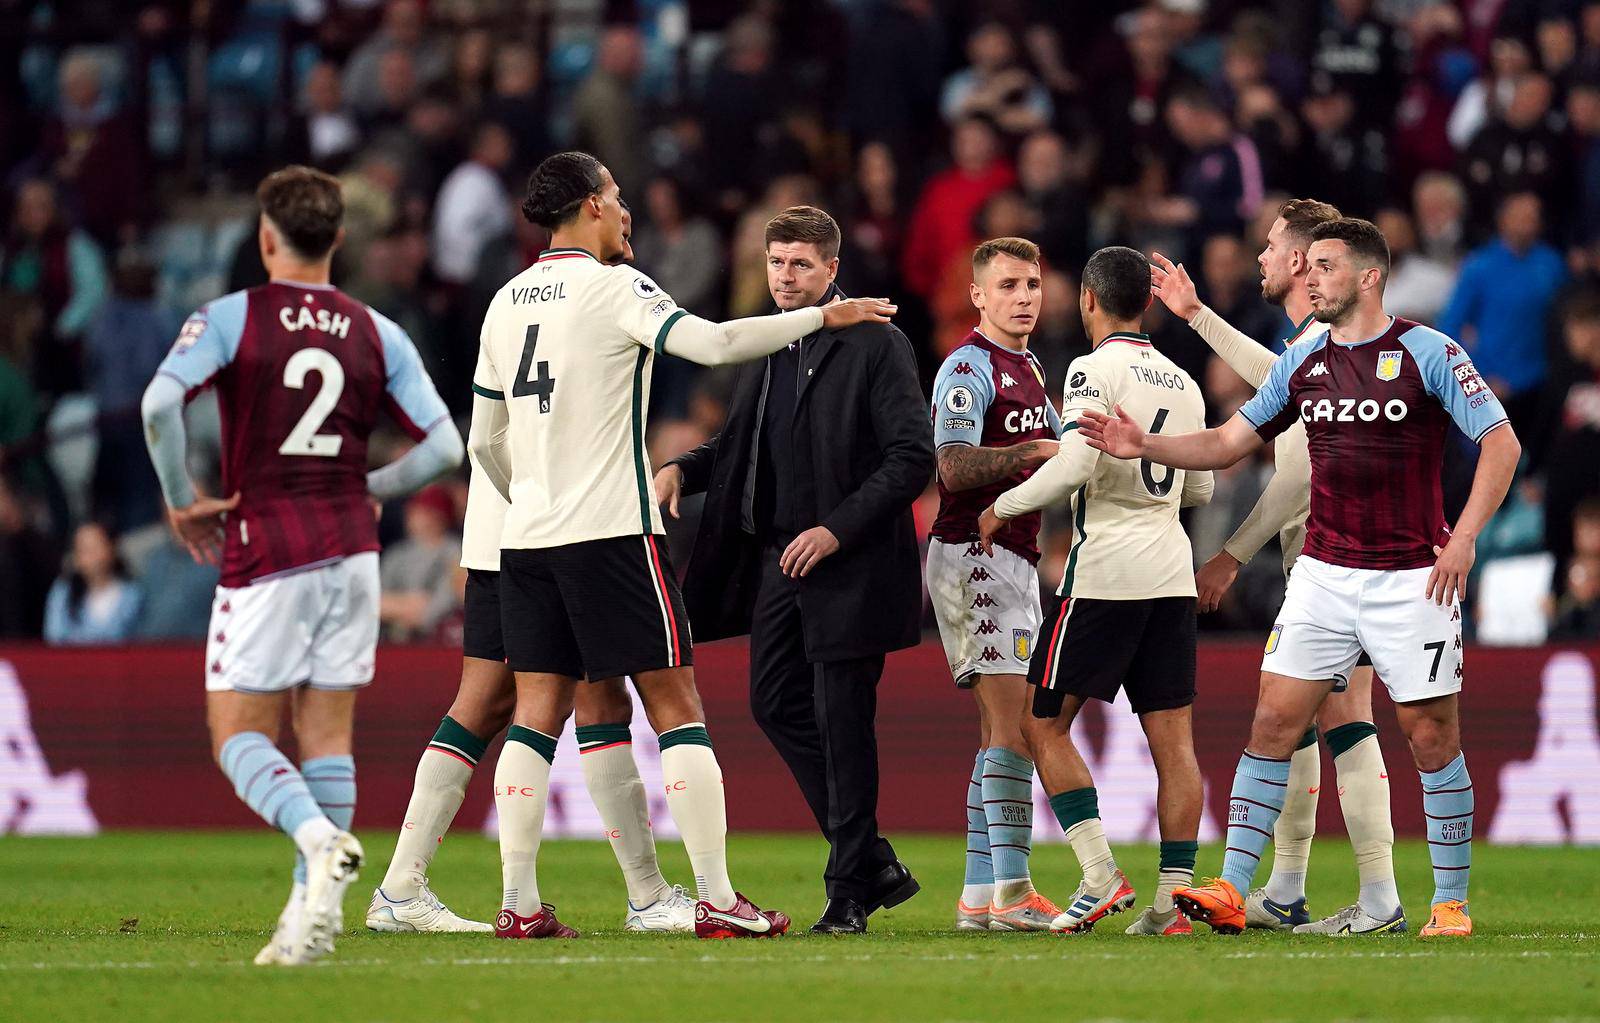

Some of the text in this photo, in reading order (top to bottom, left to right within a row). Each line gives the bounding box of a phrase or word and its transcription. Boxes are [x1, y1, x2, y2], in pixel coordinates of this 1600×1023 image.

[512, 282, 566, 305] VIRGIL
[279, 306, 351, 339] CASH
[512, 324, 555, 413] 4
[1130, 365, 1184, 391] THIAGO
[278, 347, 345, 457] 2
[1064, 386, 1100, 403] pedia
[1470, 393, 1490, 409] OB.C
[1300, 398, 1408, 422] CAZOO
[1141, 408, 1175, 497] 6
[1424, 641, 1446, 682] 7
[1003, 813, 1028, 823] VILLA
[1442, 830, 1466, 840] VILLA
